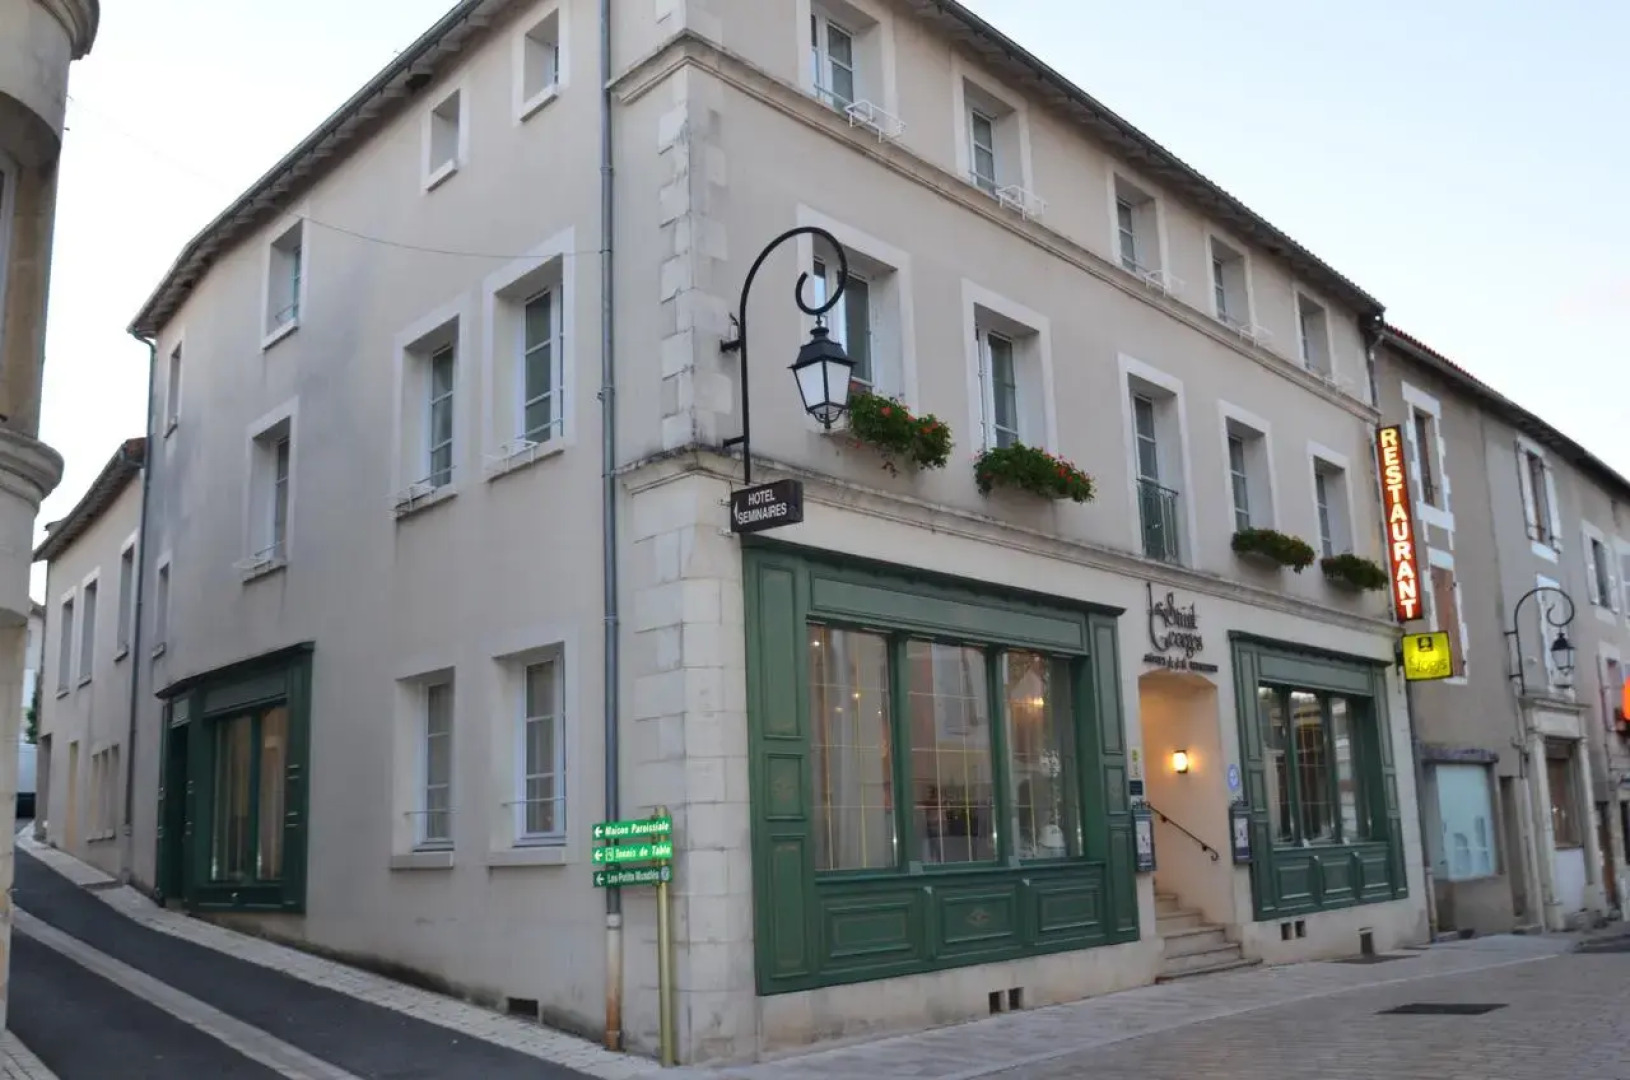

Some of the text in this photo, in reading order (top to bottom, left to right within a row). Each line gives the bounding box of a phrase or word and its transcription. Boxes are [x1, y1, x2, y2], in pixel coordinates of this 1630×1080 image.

[748, 489, 775, 506] HOTEL
[738, 502, 787, 525] SEMINAIRES
[1380, 428, 1417, 619] RESTAURANT
[605, 820, 670, 836] Maison Paroissiale
[615, 844, 671, 859] Tennis de Table
